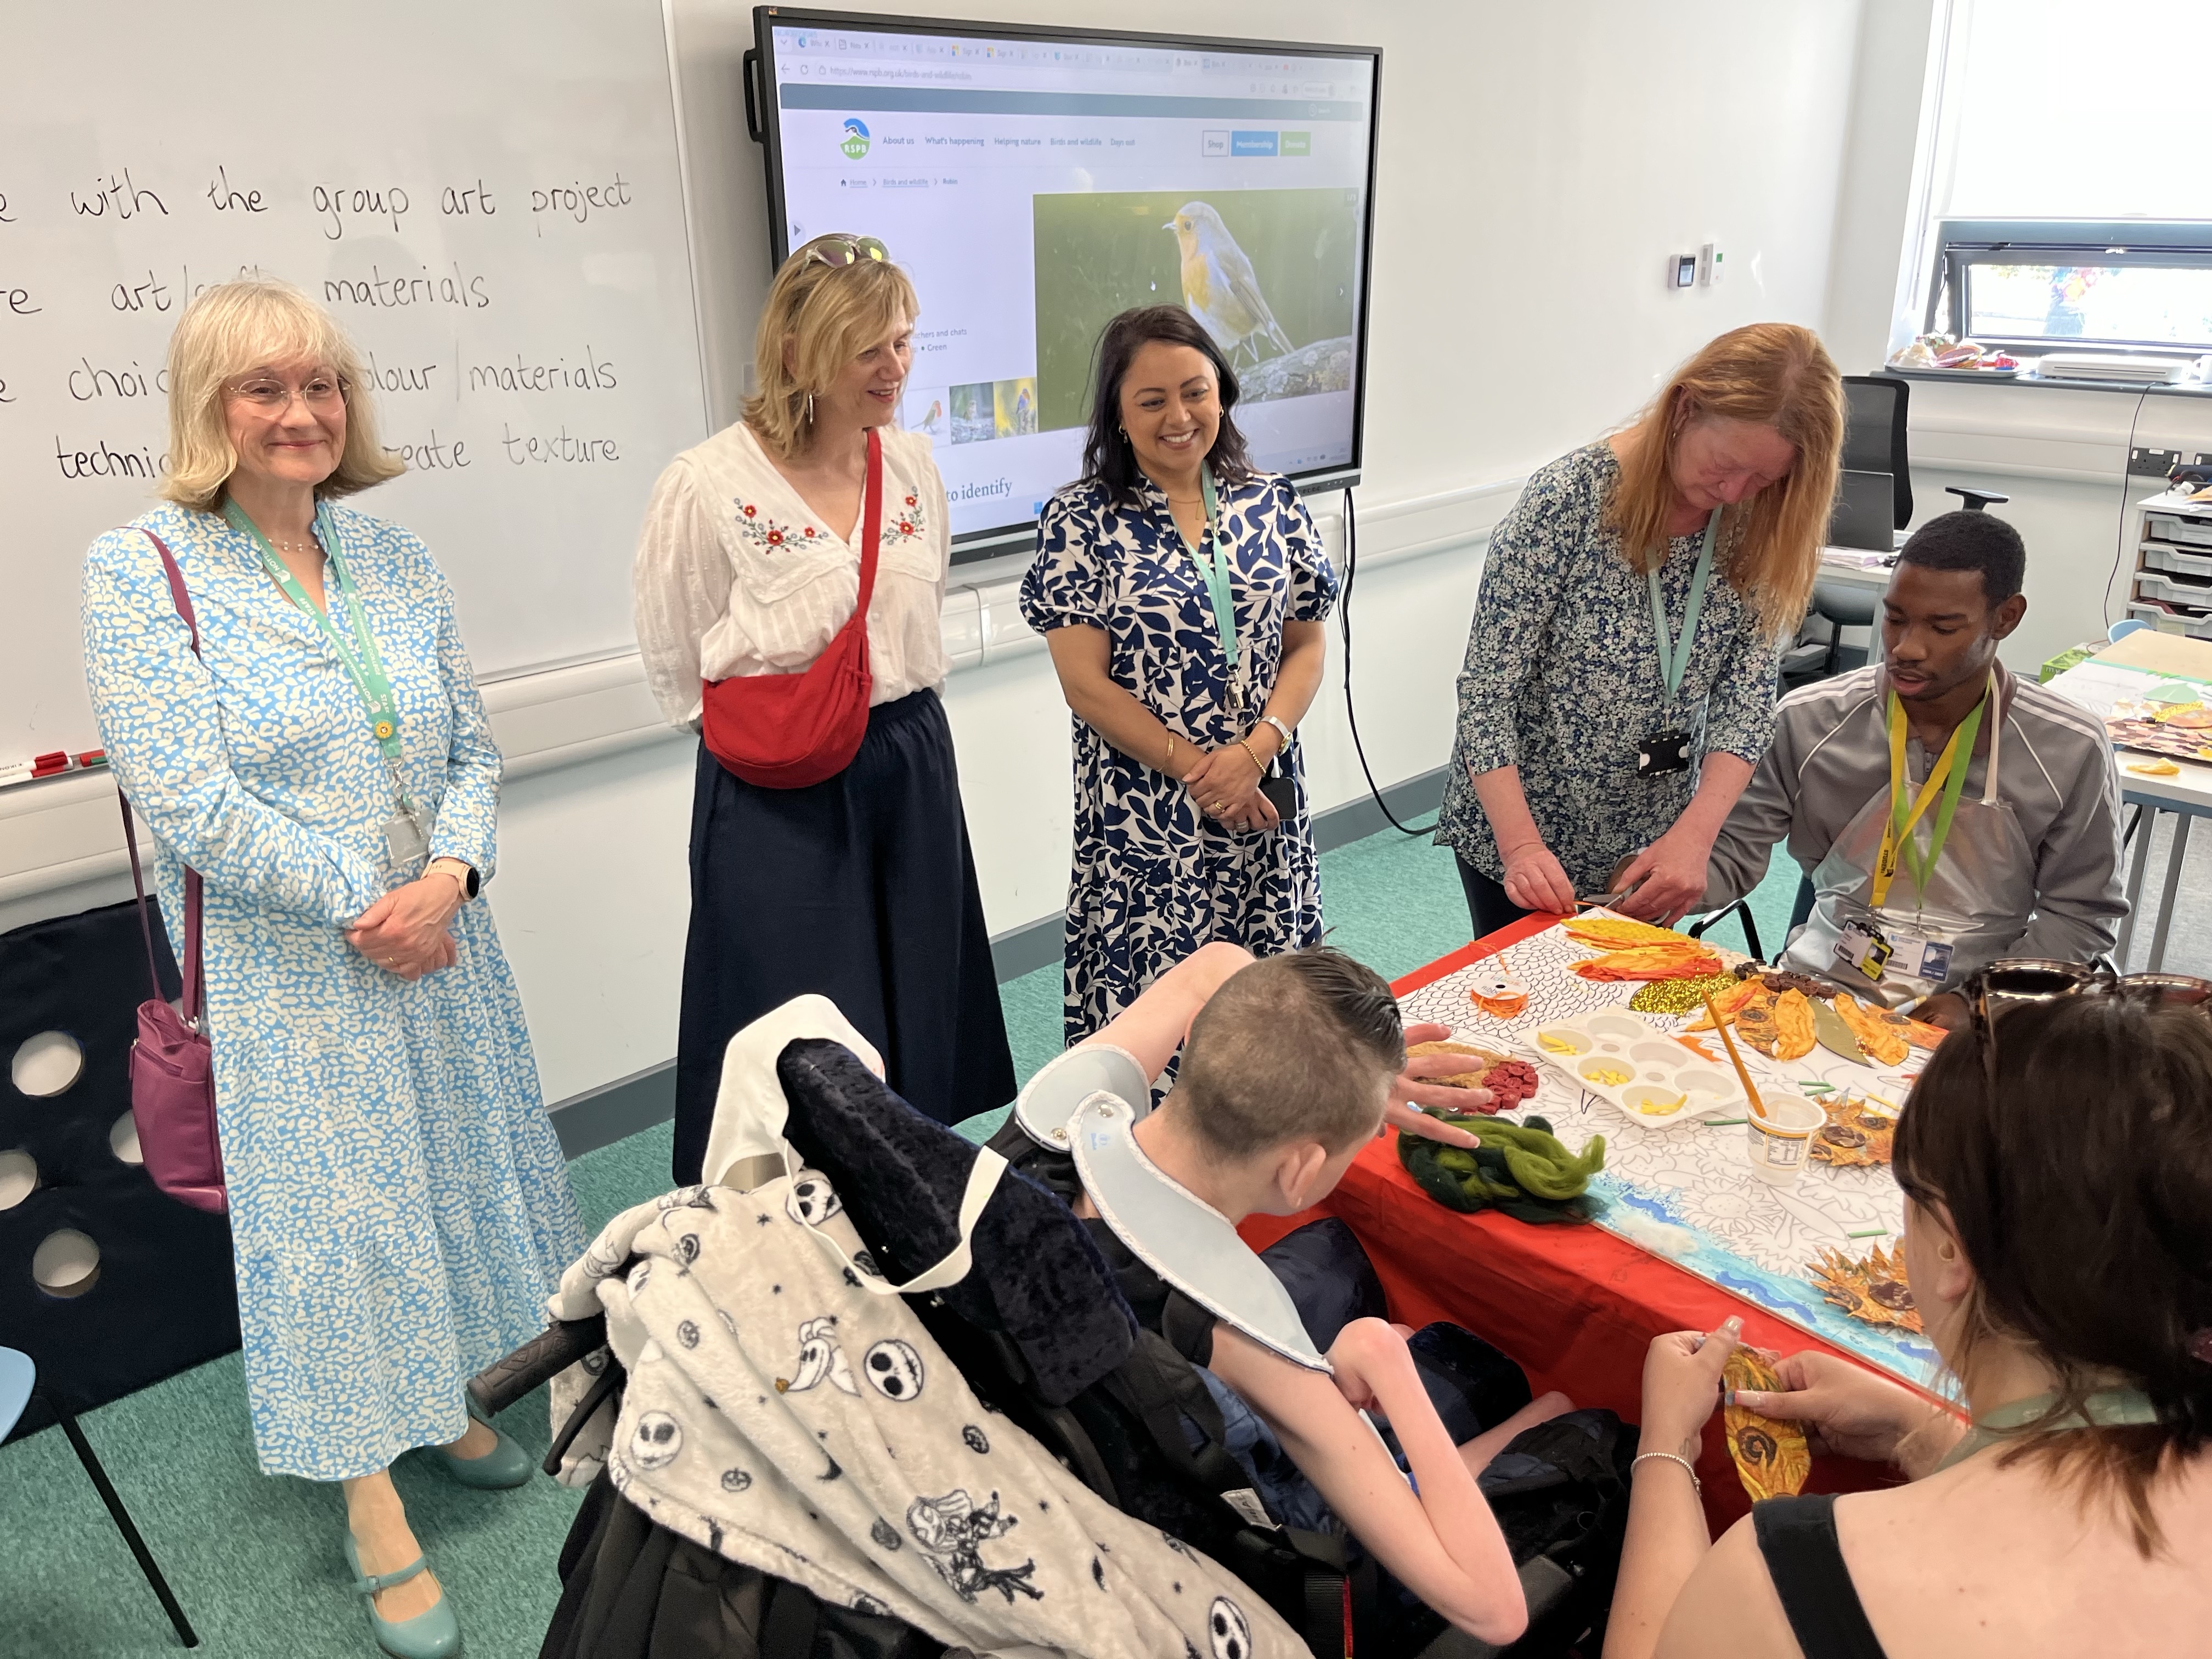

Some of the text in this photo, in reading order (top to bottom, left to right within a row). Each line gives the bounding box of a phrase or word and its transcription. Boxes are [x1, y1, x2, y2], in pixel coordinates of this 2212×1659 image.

[844, 145, 867, 154] RSPB
[925, 137, 985, 146] What's happening
[994, 137, 1019, 147] Helping
[1050, 138, 1065, 146] Birds
[1207, 140, 1224, 150] Shop
[850, 178, 867, 187] Home
[883, 178, 896, 187] Birds
[71, 167, 168, 219] with
[207, 165, 268, 212] the
[313, 185, 409, 240] group
[441, 179, 495, 215] art
[532, 172, 631, 238] project
[324, 261, 489, 308] materials
[469, 345, 617, 391] materials
[502, 423, 619, 465] texture
[946, 477, 1012, 502] to identify
[298, 596, 317, 617] STAFF
[1651, 578, 1667, 648] NOTTINGHAM COLLEGE
[368, 648, 382, 676] COLLEGE
[346, 657, 373, 702] NOTTINGHAM
